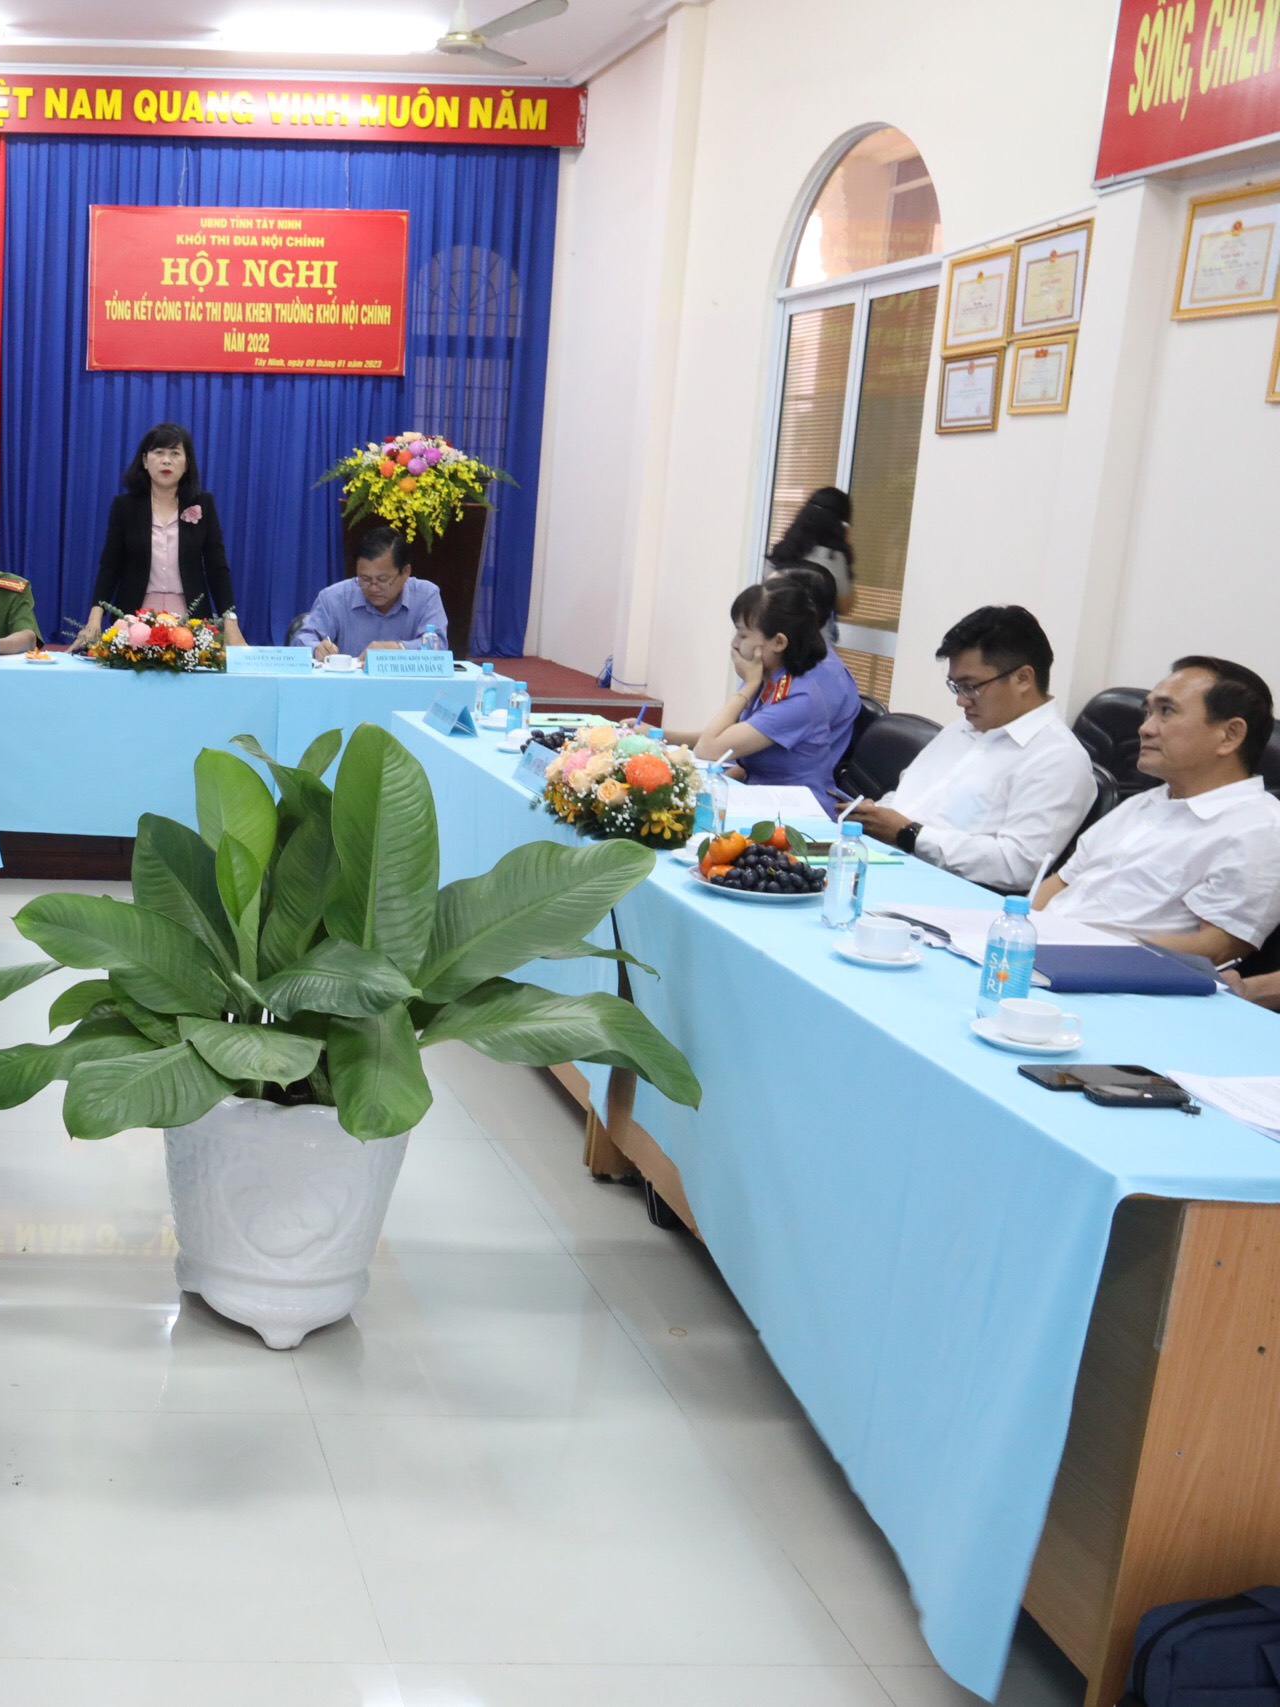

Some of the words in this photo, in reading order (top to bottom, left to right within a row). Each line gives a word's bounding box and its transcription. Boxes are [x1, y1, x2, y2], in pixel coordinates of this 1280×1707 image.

[44, 87, 122, 120] NAM
[133, 89, 255, 124] QUANG
[267, 91, 349, 126] VINH
[359, 87, 460, 128] MUÔN
[469, 89, 548, 130] NĂM
[176, 231, 207, 245] KHỐI
[210, 235, 230, 246] THI
[233, 235, 258, 246] ĐUA
[261, 234, 283, 249] NỘI
[286, 234, 325, 247] CHÍNH
[200, 217, 228, 228] UBND
[277, 219, 302, 230] NINH
[161, 250, 230, 293] HỘI
[242, 259, 339, 296] NGHỊ
[105, 289, 131, 320] TỔNG
[133, 291, 153, 320] KẾT
[154, 296, 182, 321] CÔNG
[184, 295, 203, 321] TÁC
[205, 302, 221, 321] THI
[223, 302, 243, 322] ĐUA
[245, 302, 272, 323] KHEN
[316, 295, 340, 324] KHỐI
[341, 299, 359, 330] NỘI
[361, 298, 391, 325] CHÍNH
[223, 327, 245, 352] NĂM
[247, 332, 270, 352] 2022
